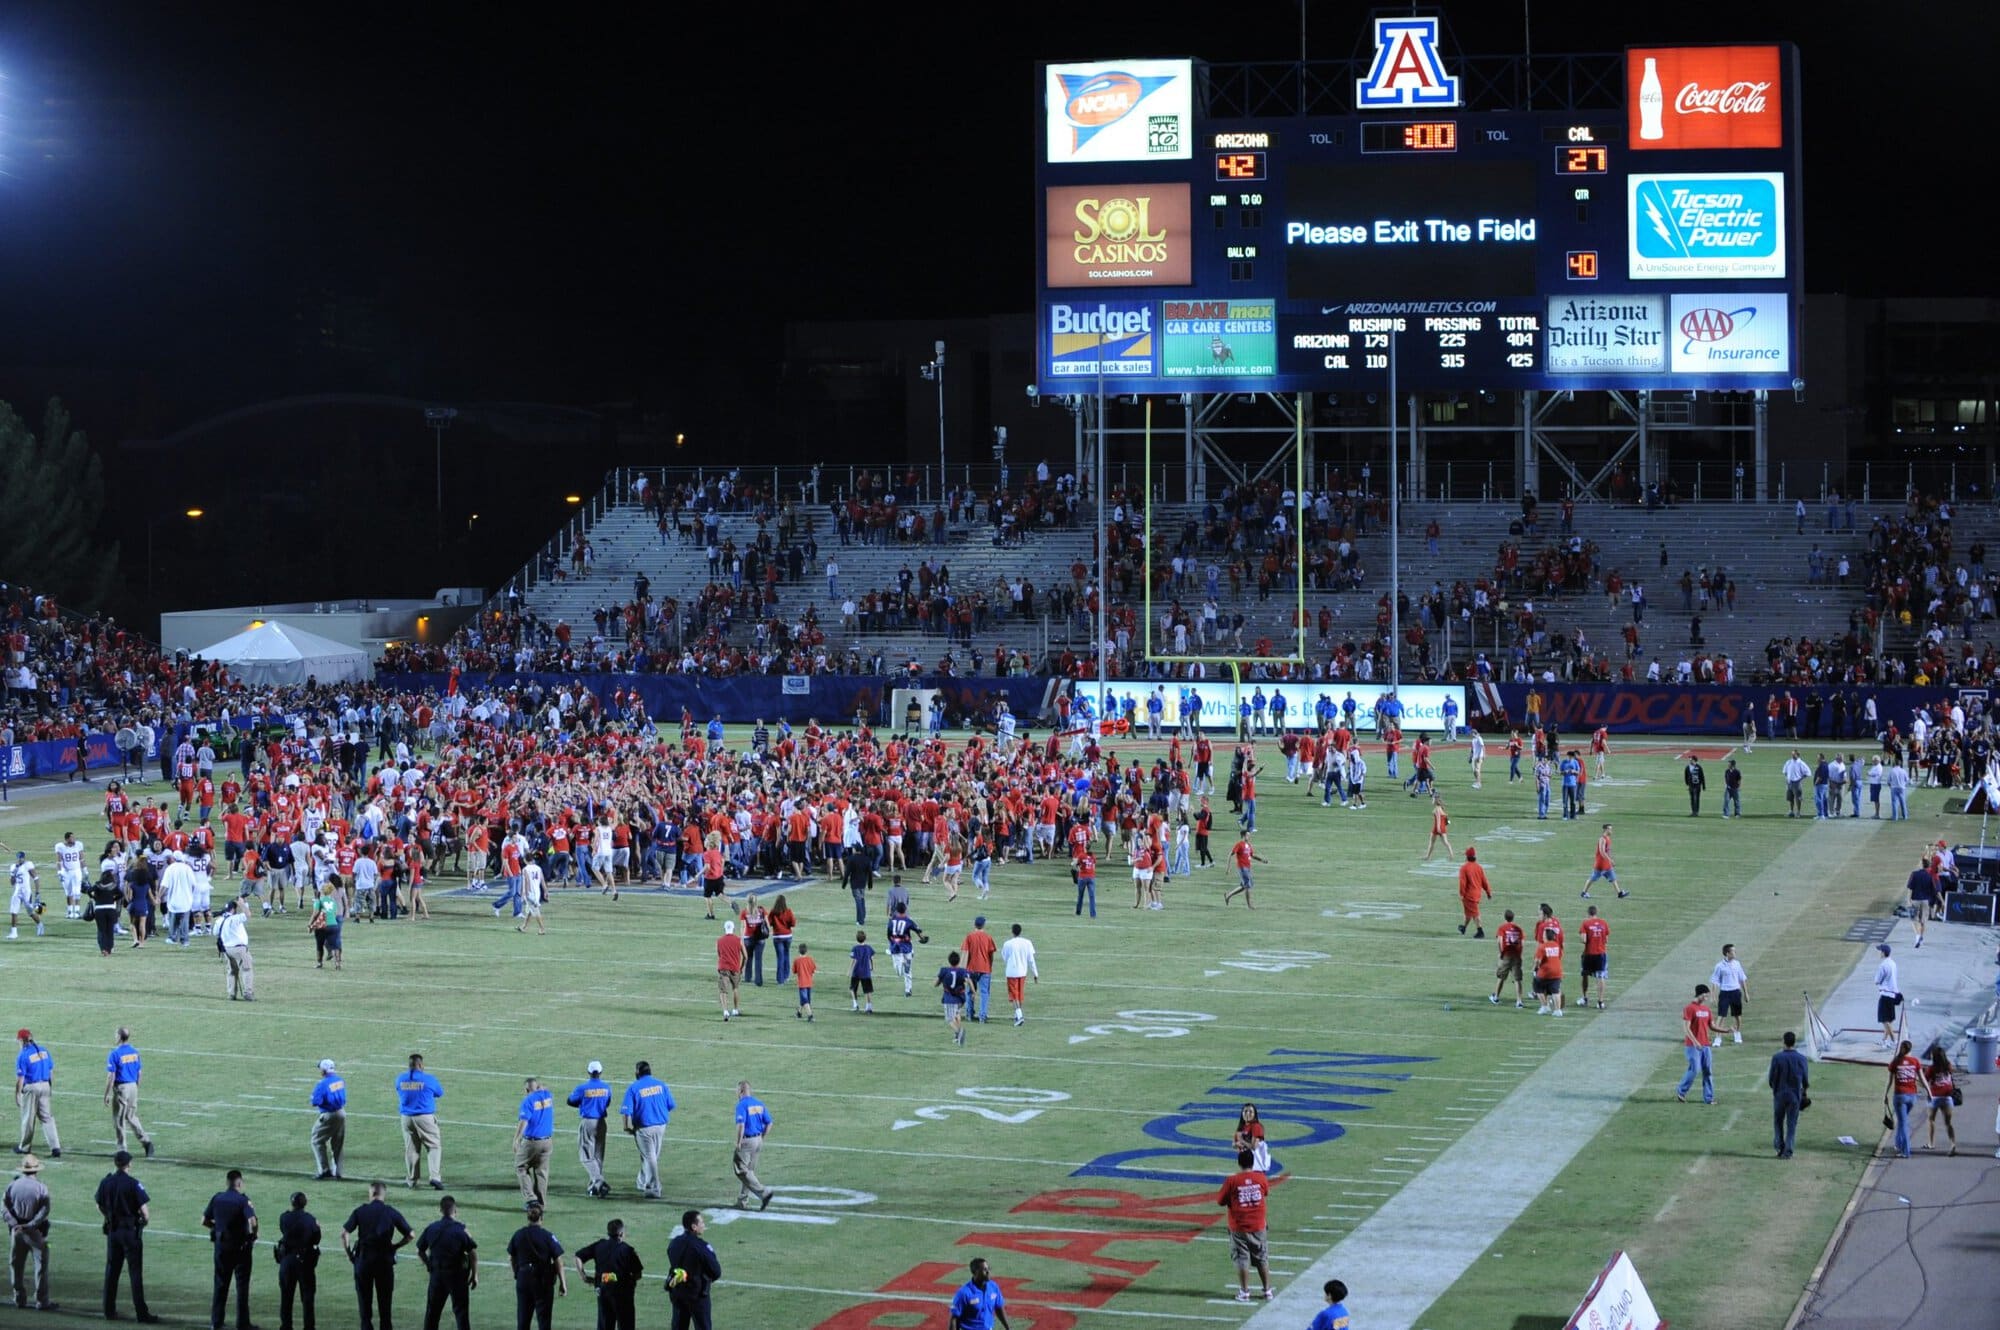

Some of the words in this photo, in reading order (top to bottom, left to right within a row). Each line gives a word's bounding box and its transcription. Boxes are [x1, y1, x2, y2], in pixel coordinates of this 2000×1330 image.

[1356, 17, 1459, 109] A
[1675, 81, 1772, 114] Coca-Cola
[1214, 133, 1269, 149] ARIZONA
[1309, 133, 1332, 145] TOL
[1486, 130, 1509, 142] TOL
[1567, 126, 1594, 143] CAL
[1218, 155, 1255, 178] 42
[1567, 149, 1606, 172] 27
[1240, 194, 1251, 206] TO
[1250, 194, 1262, 206] GO
[1574, 188, 1590, 201] QTR
[1671, 188, 1743, 209] Tucson
[1073, 197, 1167, 244] SOL
[1678, 208, 1763, 228] Electric
[1286, 220, 1368, 246] Please
[1373, 220, 1420, 244] Exit
[1424, 219, 1471, 243] The
[1478, 217, 1537, 242] Field
[1687, 228, 1763, 247] Power
[1073, 243, 1168, 265] CASINOS
[1226, 246, 1243, 259] BALL
[1244, 246, 1256, 259] ON
[1569, 252, 1596, 277] 40
[1636, 263, 1643, 273] A
[1646, 262, 1695, 273] UniSource
[1696, 263, 1729, 275] Energy
[1731, 262, 1777, 274] Company
[1088, 269, 1154, 279] SOLCASINOS.COM
[1165, 302, 1229, 321] BRAKE
[1345, 301, 1497, 315] ARIZONAATHLETICS.COM
[1560, 299, 1649, 323] Arizona
[1051, 303, 1152, 340] Budget
[1166, 320, 1188, 335] CAR
[1192, 320, 1221, 335] CARE
[1224, 319, 1273, 334] CENTERS
[1425, 317, 1482, 332] PASSING
[1497, 316, 1540, 331] TOTAL
[1681, 309, 1733, 342] AAA
[1293, 334, 1350, 349] ARIZONA
[1364, 334, 1389, 348] 179
[1439, 333, 1467, 348] 225
[1506, 332, 1534, 347] 404
[1548, 325, 1609, 352] Daily
[1614, 325, 1662, 348] Star
[1324, 354, 1350, 369] CAL
[1365, 354, 1388, 369] 110
[1440, 353, 1466, 368] 315
[1551, 355, 1566, 367] It's
[1571, 358, 1578, 367] a
[1582, 355, 1624, 367] Tucson
[1707, 346, 1781, 361] Insurance
[1054, 364, 1071, 373] car
[1073, 363, 1092, 374] and
[1094, 361, 1120, 374] tuck
[1122, 361, 1150, 373] sales
[1167, 364, 1273, 377] www.brakemax.com
[1539, 692, 1742, 726] WILDCATS
[663, 824, 672, 839] 7
[63, 852, 78, 863] 82
[1084, 1008, 1219, 1040] 30
[913, 1086, 1073, 1124] 20
